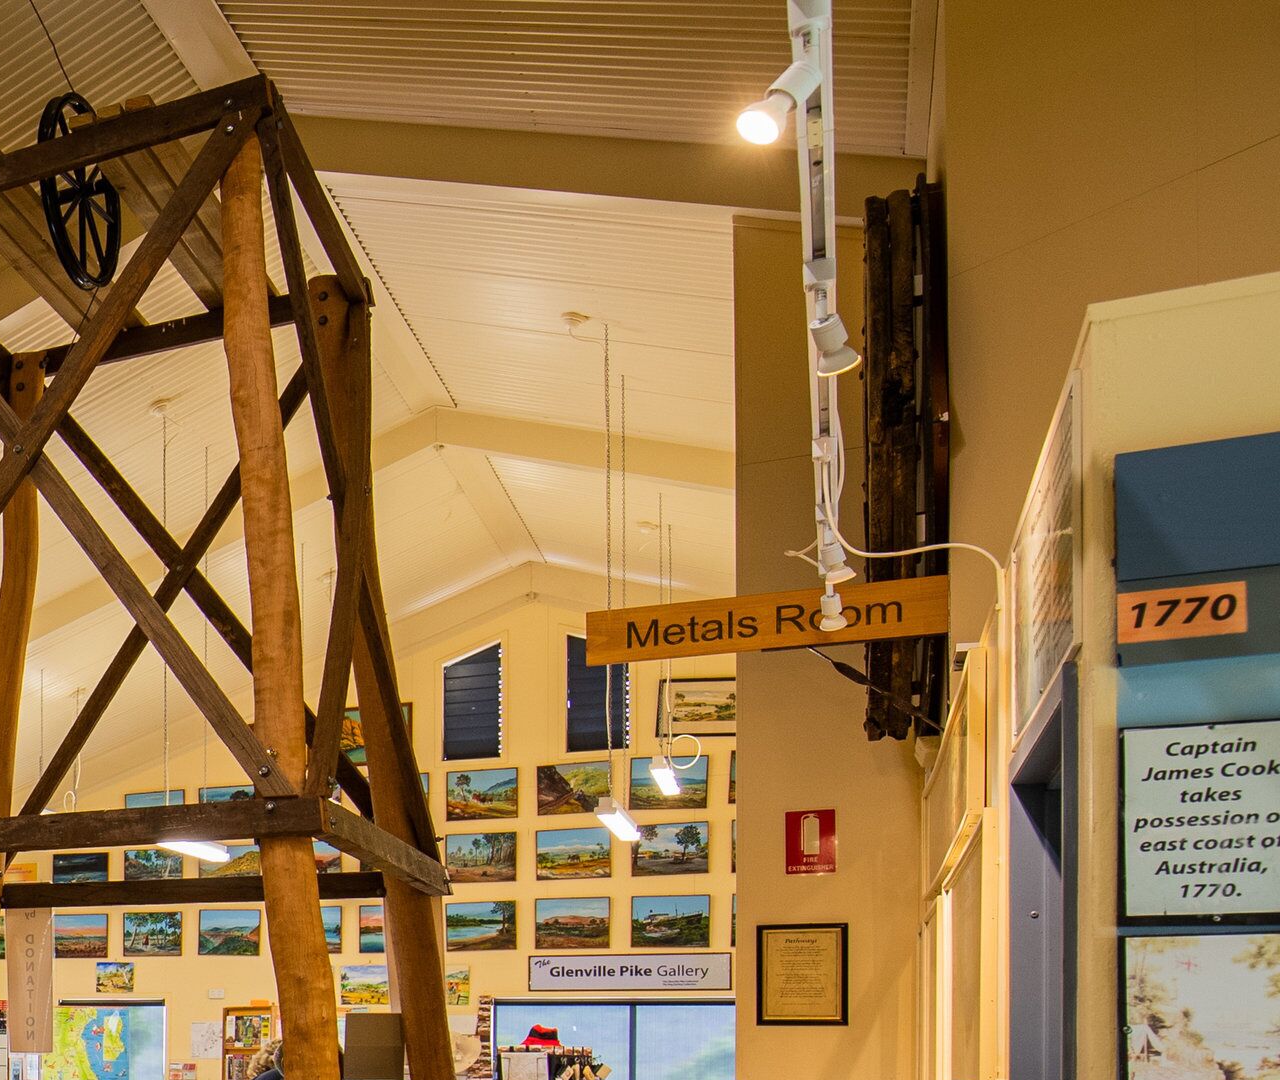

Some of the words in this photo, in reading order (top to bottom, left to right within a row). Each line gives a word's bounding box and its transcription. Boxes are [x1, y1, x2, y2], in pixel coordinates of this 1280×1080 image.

[1131, 593, 1237, 629] 1770
[626, 610, 758, 649] Metals
[1166, 737, 1257, 759] Captain
[1142, 766, 1214, 782] James
[1220, 759, 1280, 777] Cook
[1180, 787, 1242, 803] takes
[1133, 810, 1259, 833] possession
[1139, 837, 1188, 852] east
[1193, 835, 1256, 850] coast
[788, 864, 834, 872] EXTINGUISHER
[1155, 857, 1268, 876] Australia,
[1180, 883, 1242, 898] 1770.
[549, 965, 616, 978] Glenville
[619, 965, 652, 977] Pike
[657, 965, 709, 980] Gallery
